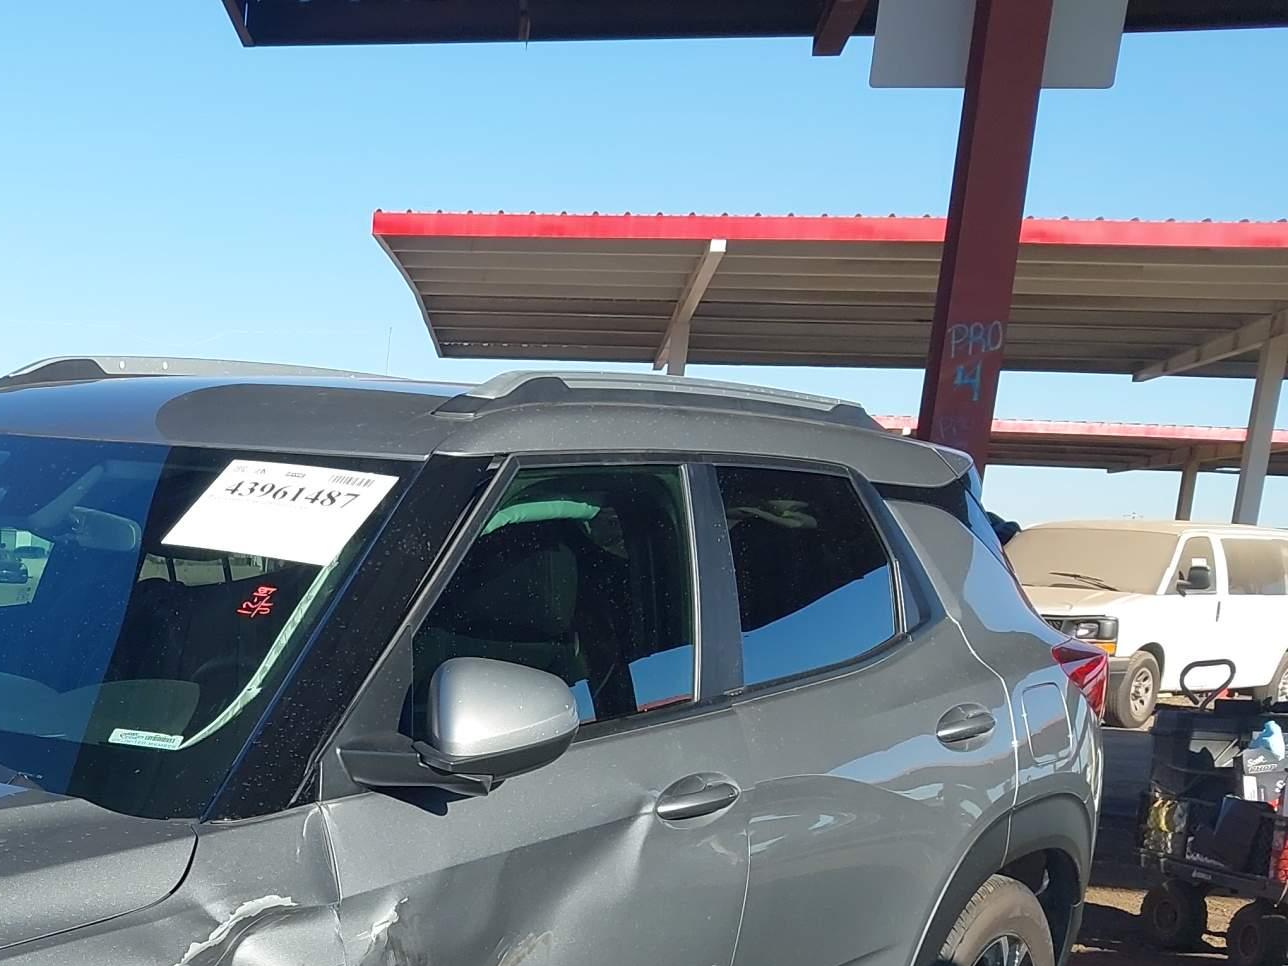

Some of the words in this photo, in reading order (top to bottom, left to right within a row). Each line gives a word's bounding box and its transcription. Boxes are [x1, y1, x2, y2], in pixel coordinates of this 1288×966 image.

[947, 319, 1004, 358] PRO
[952, 360, 983, 402] 4
[224, 480, 361, 509] 43961487
